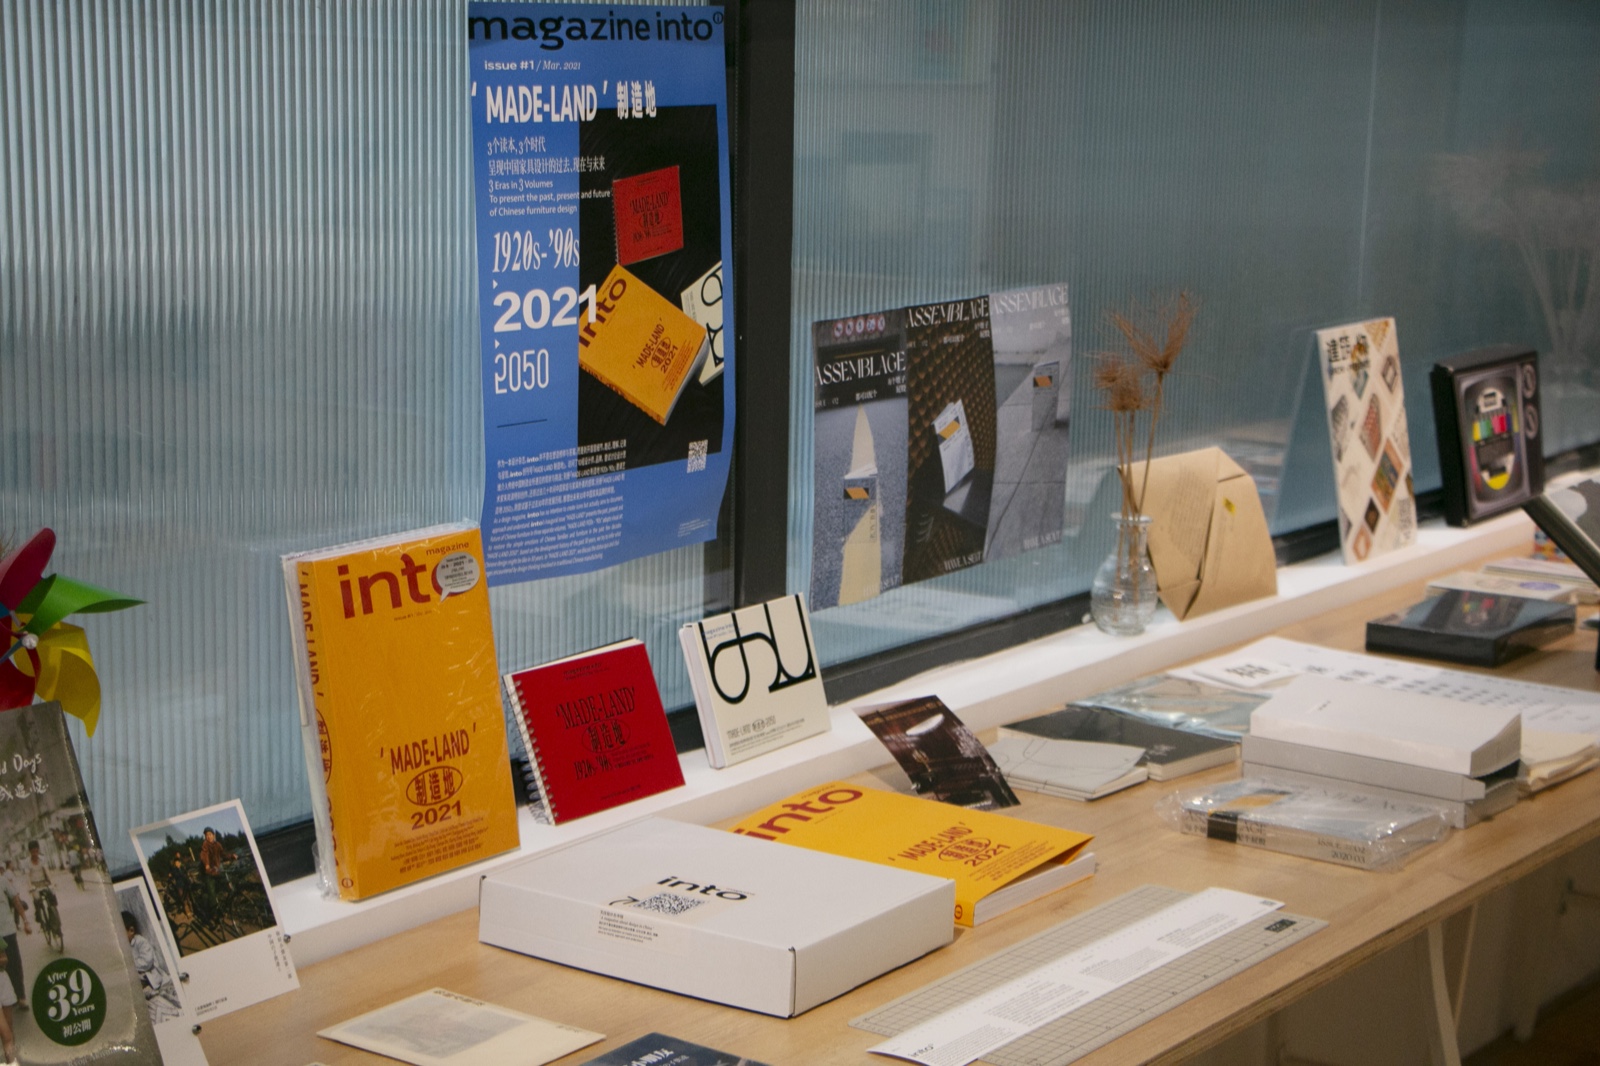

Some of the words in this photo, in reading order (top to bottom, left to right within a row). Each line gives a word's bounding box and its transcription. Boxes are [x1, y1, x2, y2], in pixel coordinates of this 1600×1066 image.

[468, 10, 651, 51] magazine
[655, 11, 714, 42] into
[484, 60, 518, 71] issue
[520, 60, 535, 71] #1
[542, 60, 563, 71] Mar.
[563, 61, 582, 71] 2021
[616, 79, 657, 121] 制造地
[488, 179, 494, 193] 3
[495, 181, 510, 190] Eras
[511, 181, 518, 190] in
[518, 178, 524, 192] 3
[524, 180, 554, 189] Volumes
[489, 195, 498, 204] To
[499, 193, 526, 206] present
[526, 193, 538, 203] the
[539, 192, 556, 203] past,
[556, 191, 580, 203] present
[581, 190, 592, 199] and
[592, 189, 611, 199] future
[489, 207, 497, 217] of
[498, 206, 526, 217] Chinese
[526, 205, 556, 215] furniture
[557, 204, 578, 216] design
[493, 283, 598, 333] 2021
[494, 348, 550, 394] 2050
[425, 542, 470, 556] magazine
[337, 553, 467, 620] int
[13, 753, 42, 774] Days
[414, 767, 456, 805] 制造地
[410, 800, 463, 831] 2021
[733, 789, 863, 842] into
[964, 844, 1011, 868] 2021
[656, 875, 748, 901] into
[47, 970, 69, 985] After
[48, 968, 93, 1022] 39
[71, 1003, 96, 1017] Years
[62, 1018, 92, 1039] 初公開
